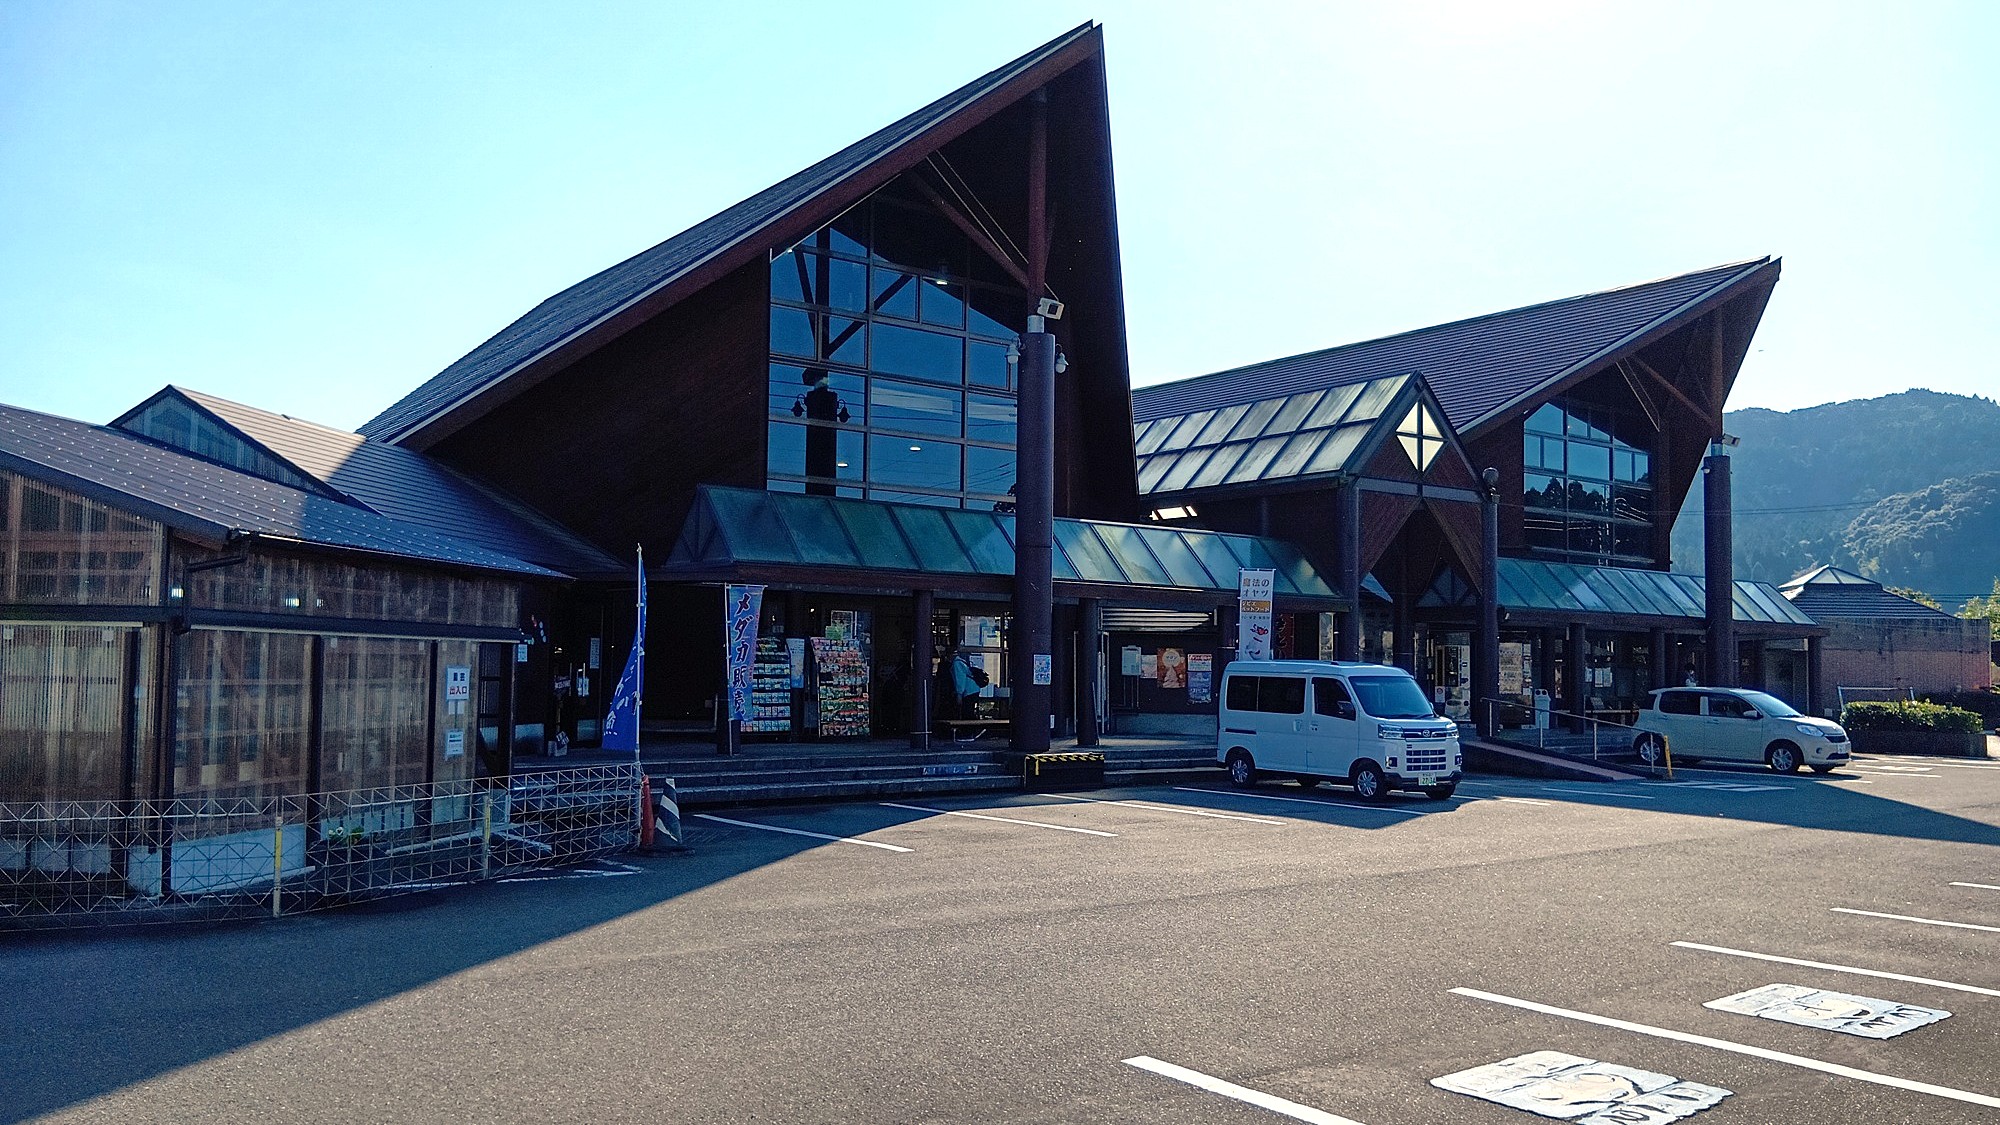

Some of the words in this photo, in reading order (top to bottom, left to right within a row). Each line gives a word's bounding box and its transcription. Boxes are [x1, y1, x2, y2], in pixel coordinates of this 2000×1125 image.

[1243, 578, 1270, 587] 魔法の
[1243, 589, 1269, 597] オヤツ
[734, 593, 755, 715] メダカ販売
[449, 686, 468, 695] 出入口
